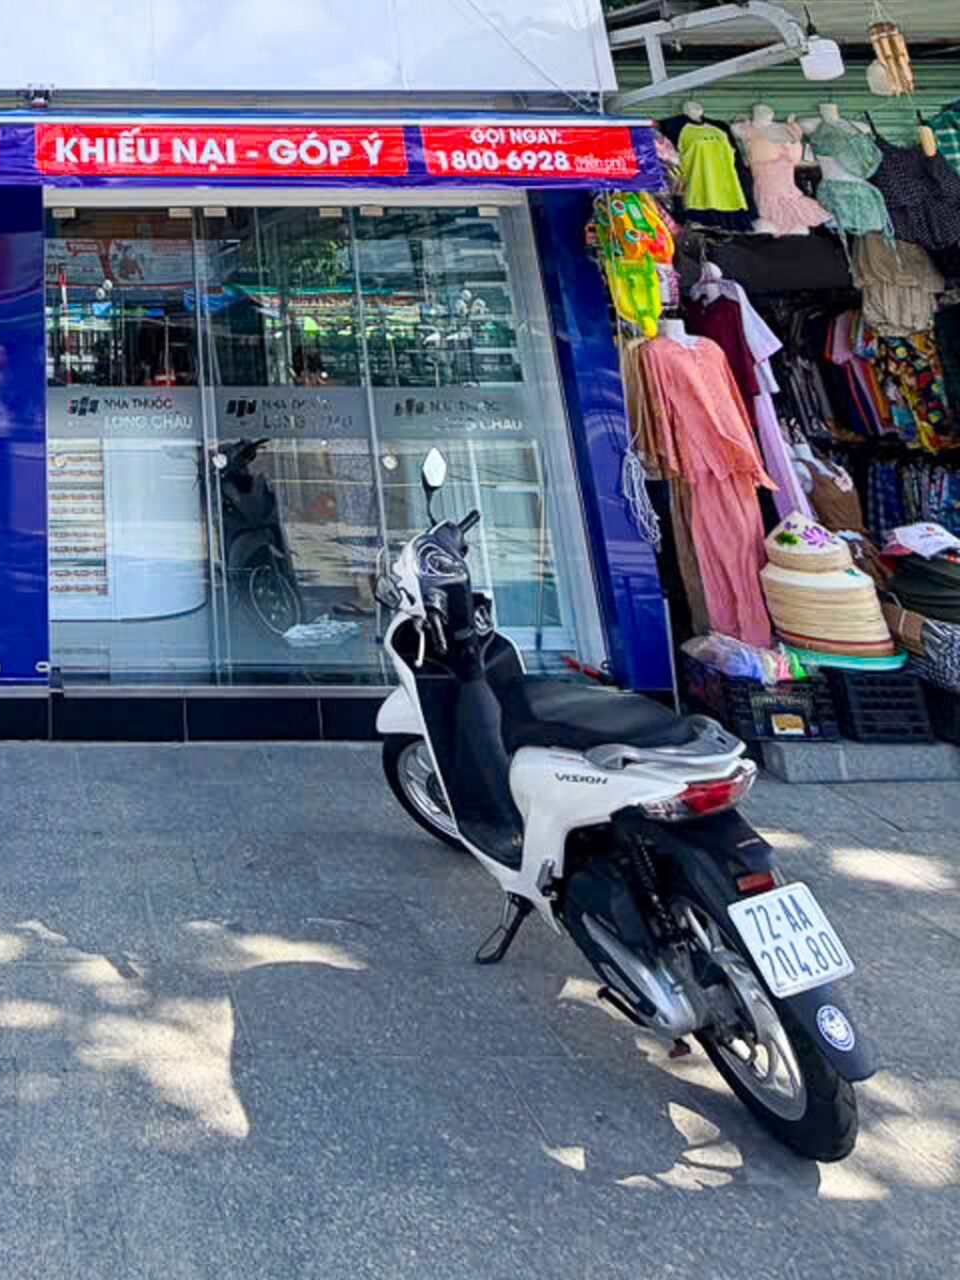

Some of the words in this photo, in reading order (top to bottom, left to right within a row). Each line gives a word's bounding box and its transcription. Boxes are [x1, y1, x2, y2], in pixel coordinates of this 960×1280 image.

[470, 129, 504, 148] GỌI
[510, 129, 563, 145] NGAY:
[55, 127, 160, 163] KHIẾU
[173, 138, 236, 171] NẠI
[269, 130, 352, 166] GÓP
[360, 132, 383, 166] Ý
[435, 150, 499, 171] 1800
[506, 150, 569, 171] 6928
[555, 772, 609, 785] VISION
